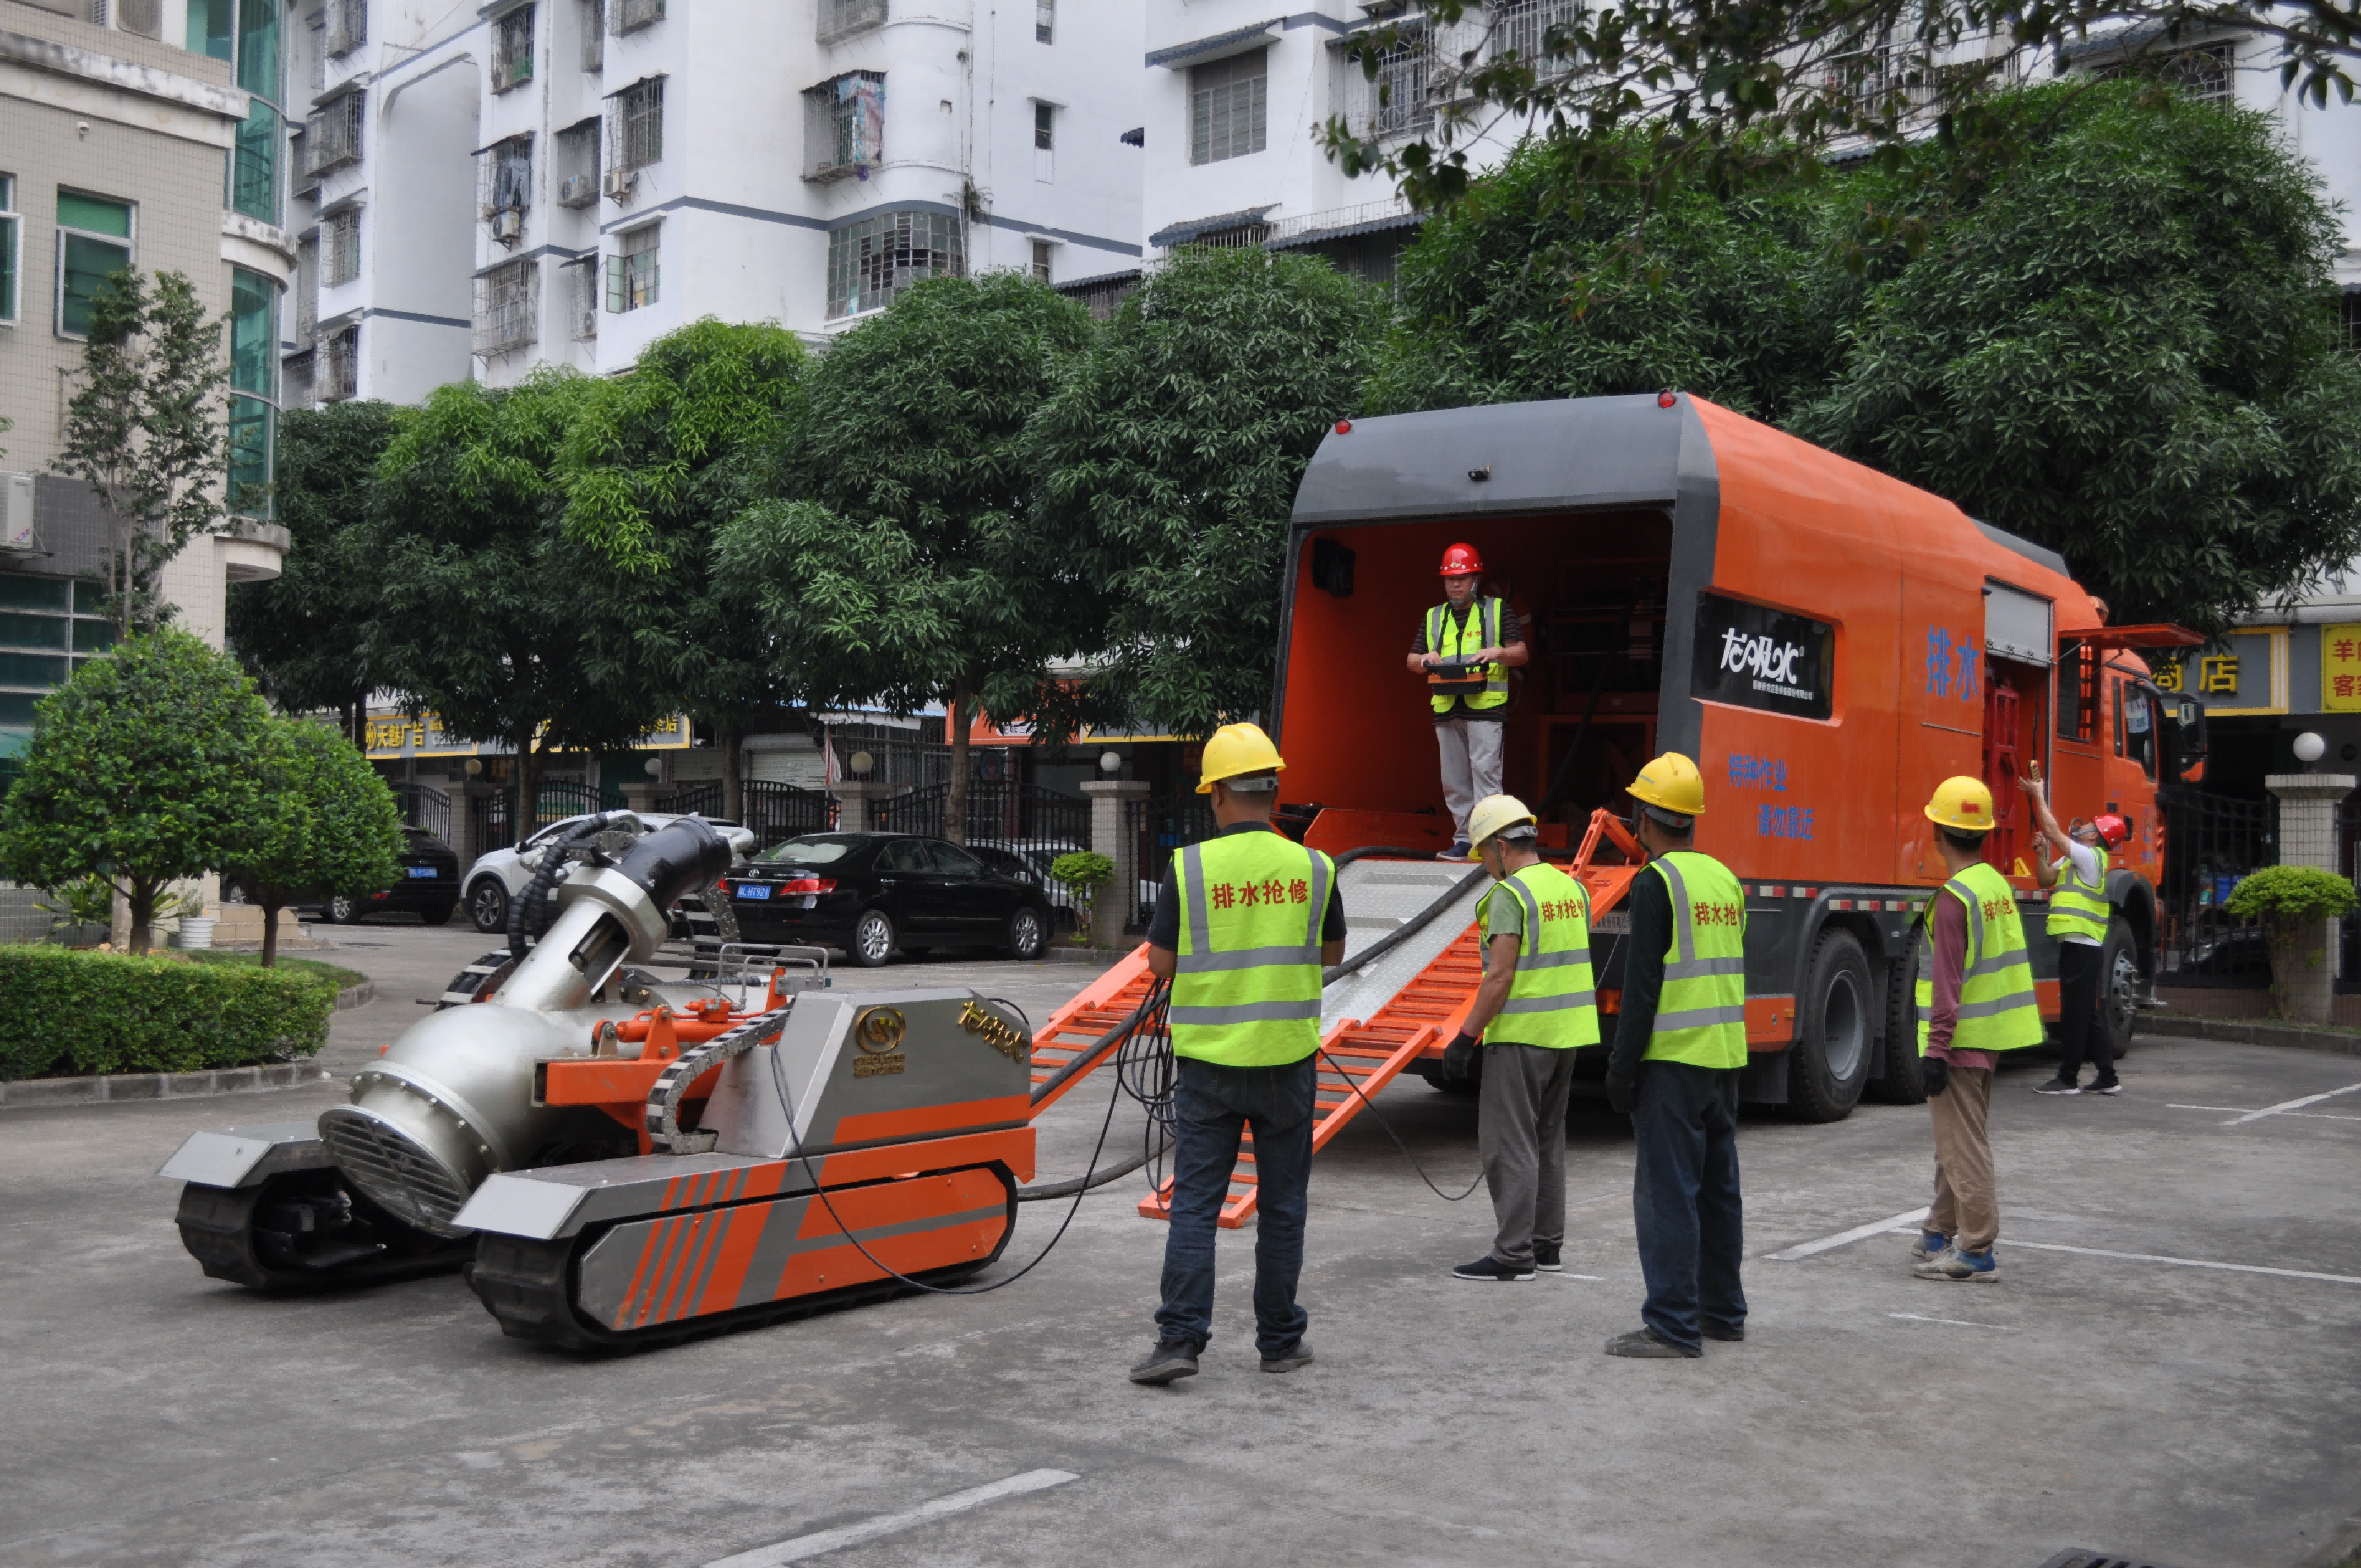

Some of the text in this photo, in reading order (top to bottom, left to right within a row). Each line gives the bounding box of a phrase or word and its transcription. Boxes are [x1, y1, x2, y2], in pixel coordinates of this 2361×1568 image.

[1926, 624, 1979, 702] 排水
[2332, 639, 2361, 662] 羊
[2332, 674, 2361, 697] 客
[1728, 752, 1787, 791] 特种作业
[1758, 803, 1813, 840] 请勿靠近
[1212, 878, 1309, 910] 排水抢修
[1694, 902, 1740, 926] 排水抢
